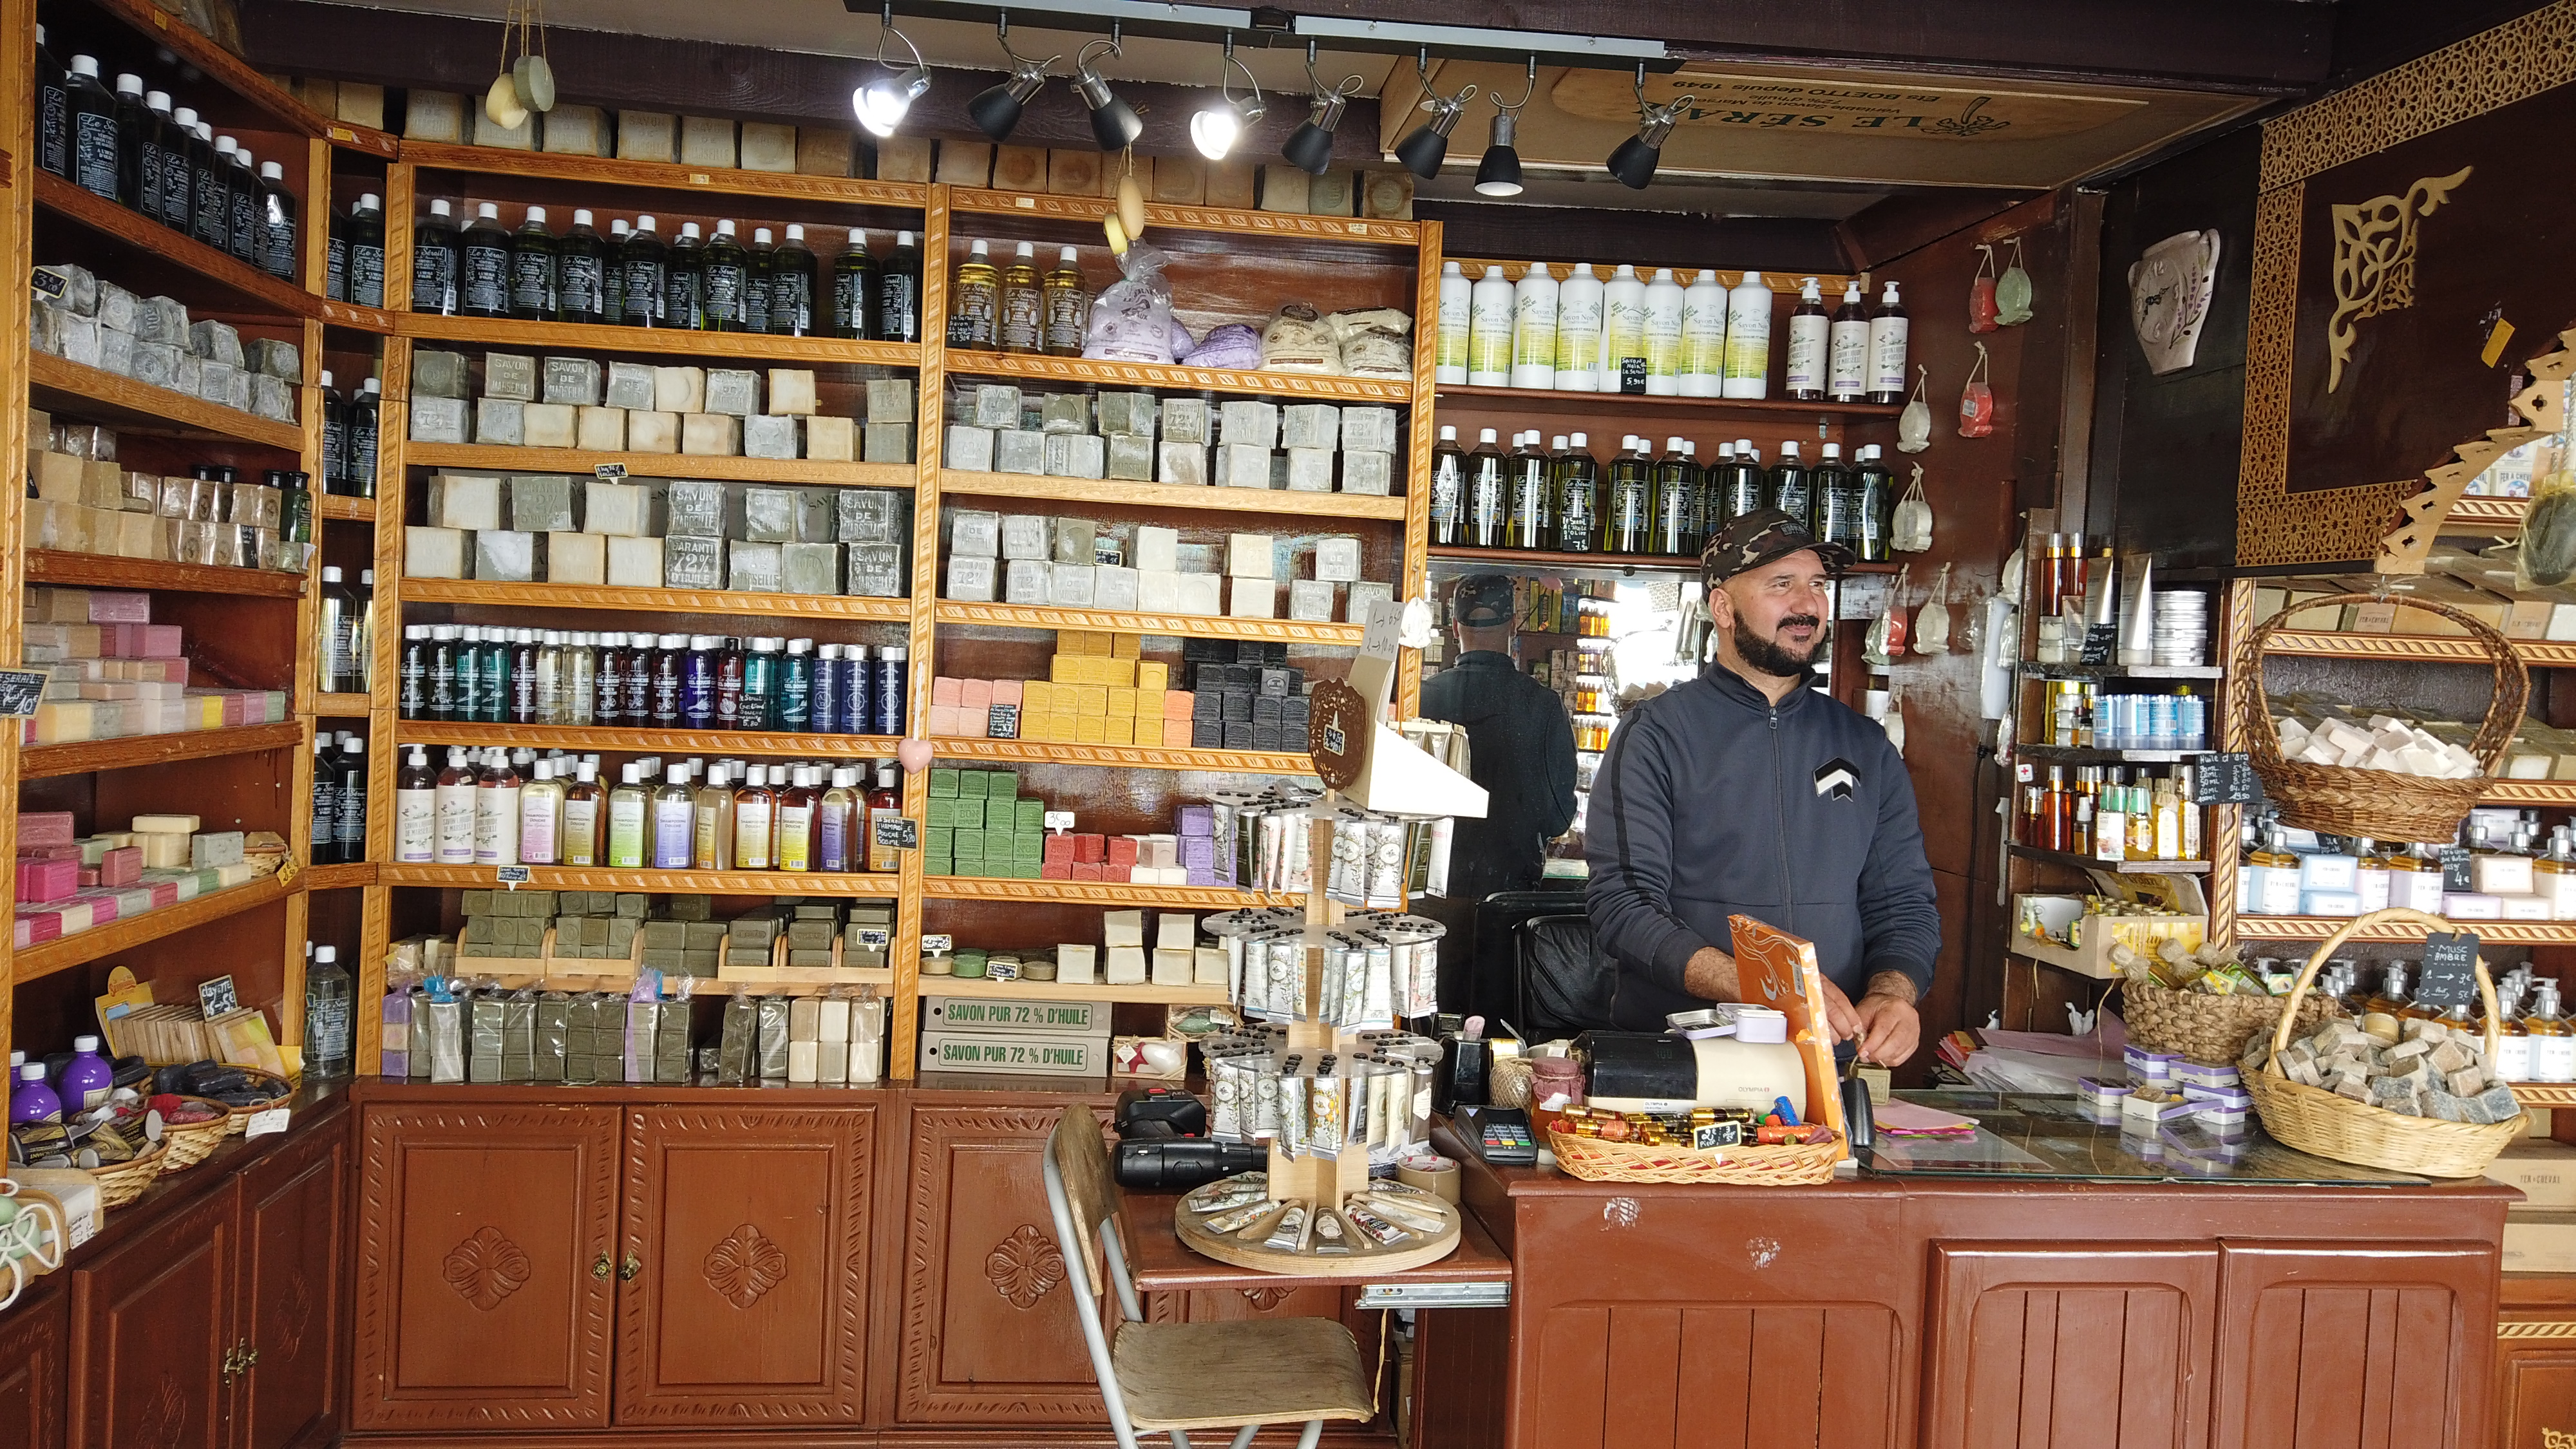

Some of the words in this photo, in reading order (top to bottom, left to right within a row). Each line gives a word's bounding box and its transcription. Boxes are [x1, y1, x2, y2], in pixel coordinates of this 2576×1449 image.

[1732, 84, 1803, 94] depuis
[1808, 90, 1902, 100] BOETTO
[1777, 101, 1828, 109] Savon
[80, 116, 102, 128] Le
[1851, 116, 1924, 128] LE
[421, 247, 444, 257] Sérail
[468, 248, 482, 256] Le
[483, 249, 505, 260] Sérail
[527, 254, 547, 263] Sérail
[573, 257, 592, 266] Sérail
[1062, 290, 1082, 300] Sérail
[1282, 321, 1313, 332] COPEAUX
[495, 359, 528, 371] SAVON
[552, 362, 585, 373] SAVON
[504, 372, 518, 381] DE
[560, 375, 575, 383] DE
[2501, 472, 2510, 482] FER
[676, 490, 713, 502] SAVON
[686, 503, 703, 511] DE
[846, 498, 880, 509] SAVON
[855, 512, 871, 520] DE
[969, 527, 983, 535] DE
[857, 552, 894, 562] SAVON
[673, 553, 709, 572] 72%
[866, 564, 883, 573] DE
[1358, 587, 1387, 596] SAVON
[948, 1003, 984, 1021] SAVON
[988, 1005, 1011, 1022] PUR
[1014, 1007, 1030, 1023] 72
[1034, 1007, 1043, 1024] %
[1047, 1008, 1088, 1025] D'HUILE
[943, 1044, 980, 1061] SAVON
[983, 1046, 1006, 1062] PUR
[1010, 1046, 1025, 1063] 72
[1028, 1047, 1039, 1064] %
[1042, 1048, 1083, 1066] D'HUILE
